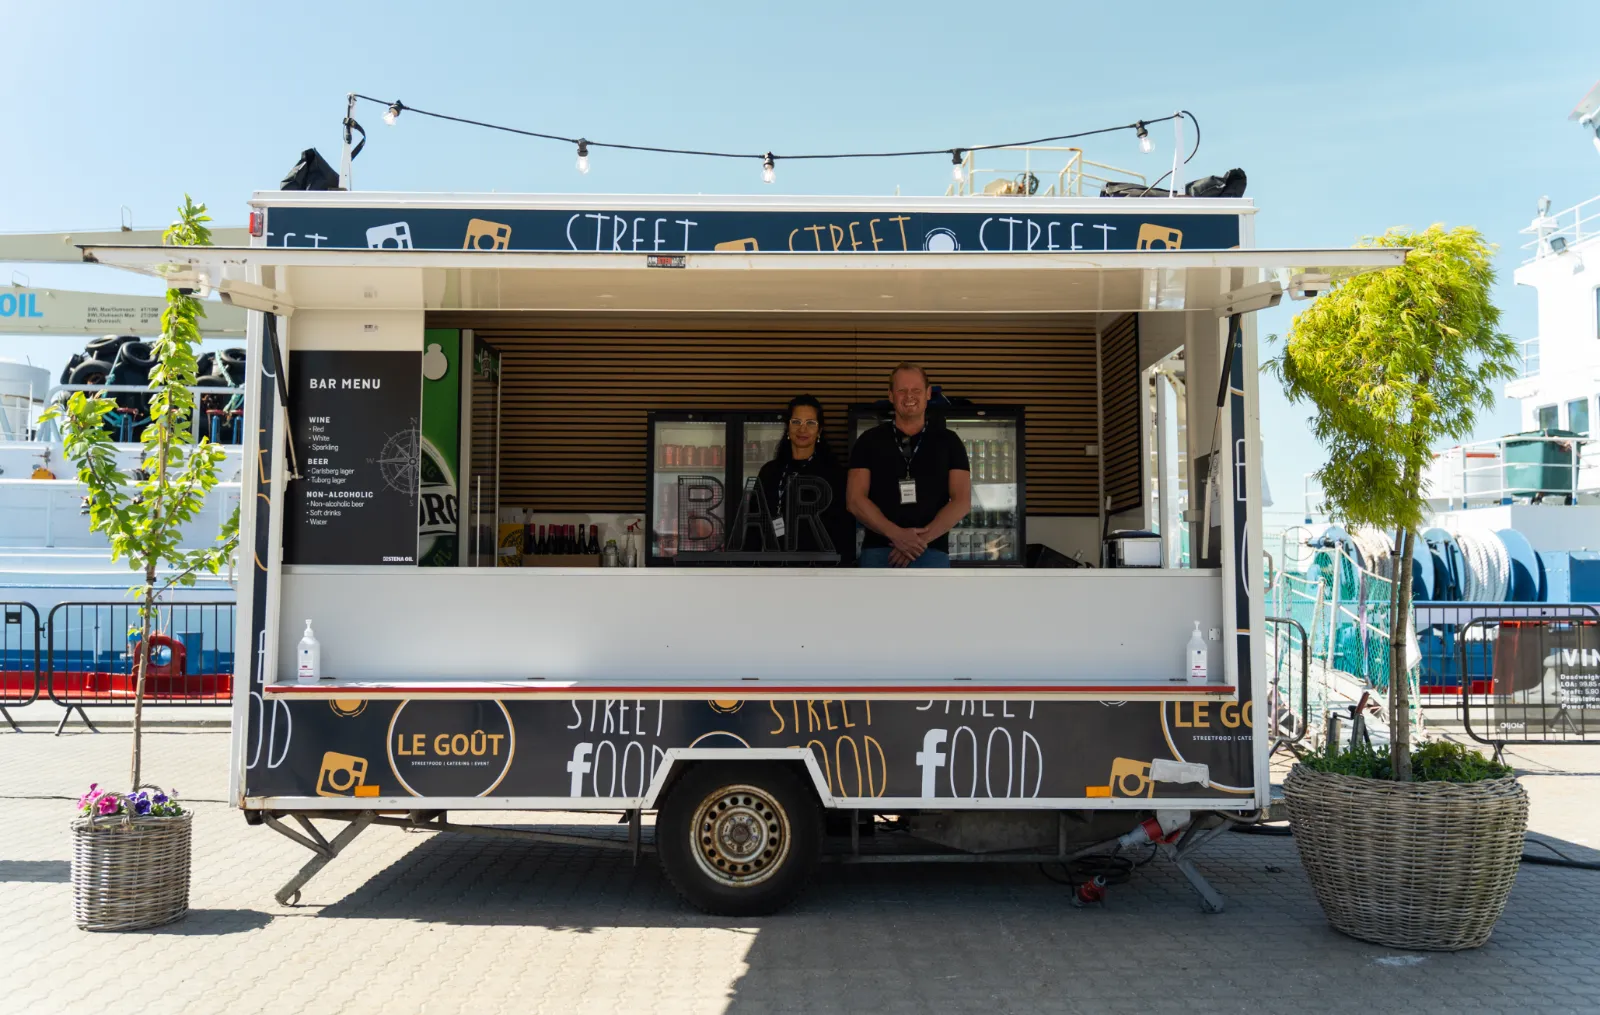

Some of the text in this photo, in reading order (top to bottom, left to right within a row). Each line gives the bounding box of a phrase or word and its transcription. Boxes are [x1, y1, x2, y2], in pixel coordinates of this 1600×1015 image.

[566, 213, 698, 250] STREET
[979, 216, 1117, 250] STREET
[0, 293, 43, 318] OIL
[309, 378, 381, 389] BAR MENU
[309, 416, 331, 424] WINE
[312, 425, 325, 433] Red
[312, 434, 330, 442] White
[312, 443, 339, 452] Sparkling
[311, 467, 355, 476] Carlsberg lager
[311, 476, 347, 485] Tuborg lager
[306, 491, 374, 499] NON-ALCOHOLIC
[310, 500, 365, 508] Non-alcoholic beer
[310, 509, 342, 517] Soft drinks
[677, 474, 836, 552] BAR
[1174, 700, 1211, 728] LE
[397, 729, 504, 756] LE GOÛT
[786, 735, 887, 798] OOD
